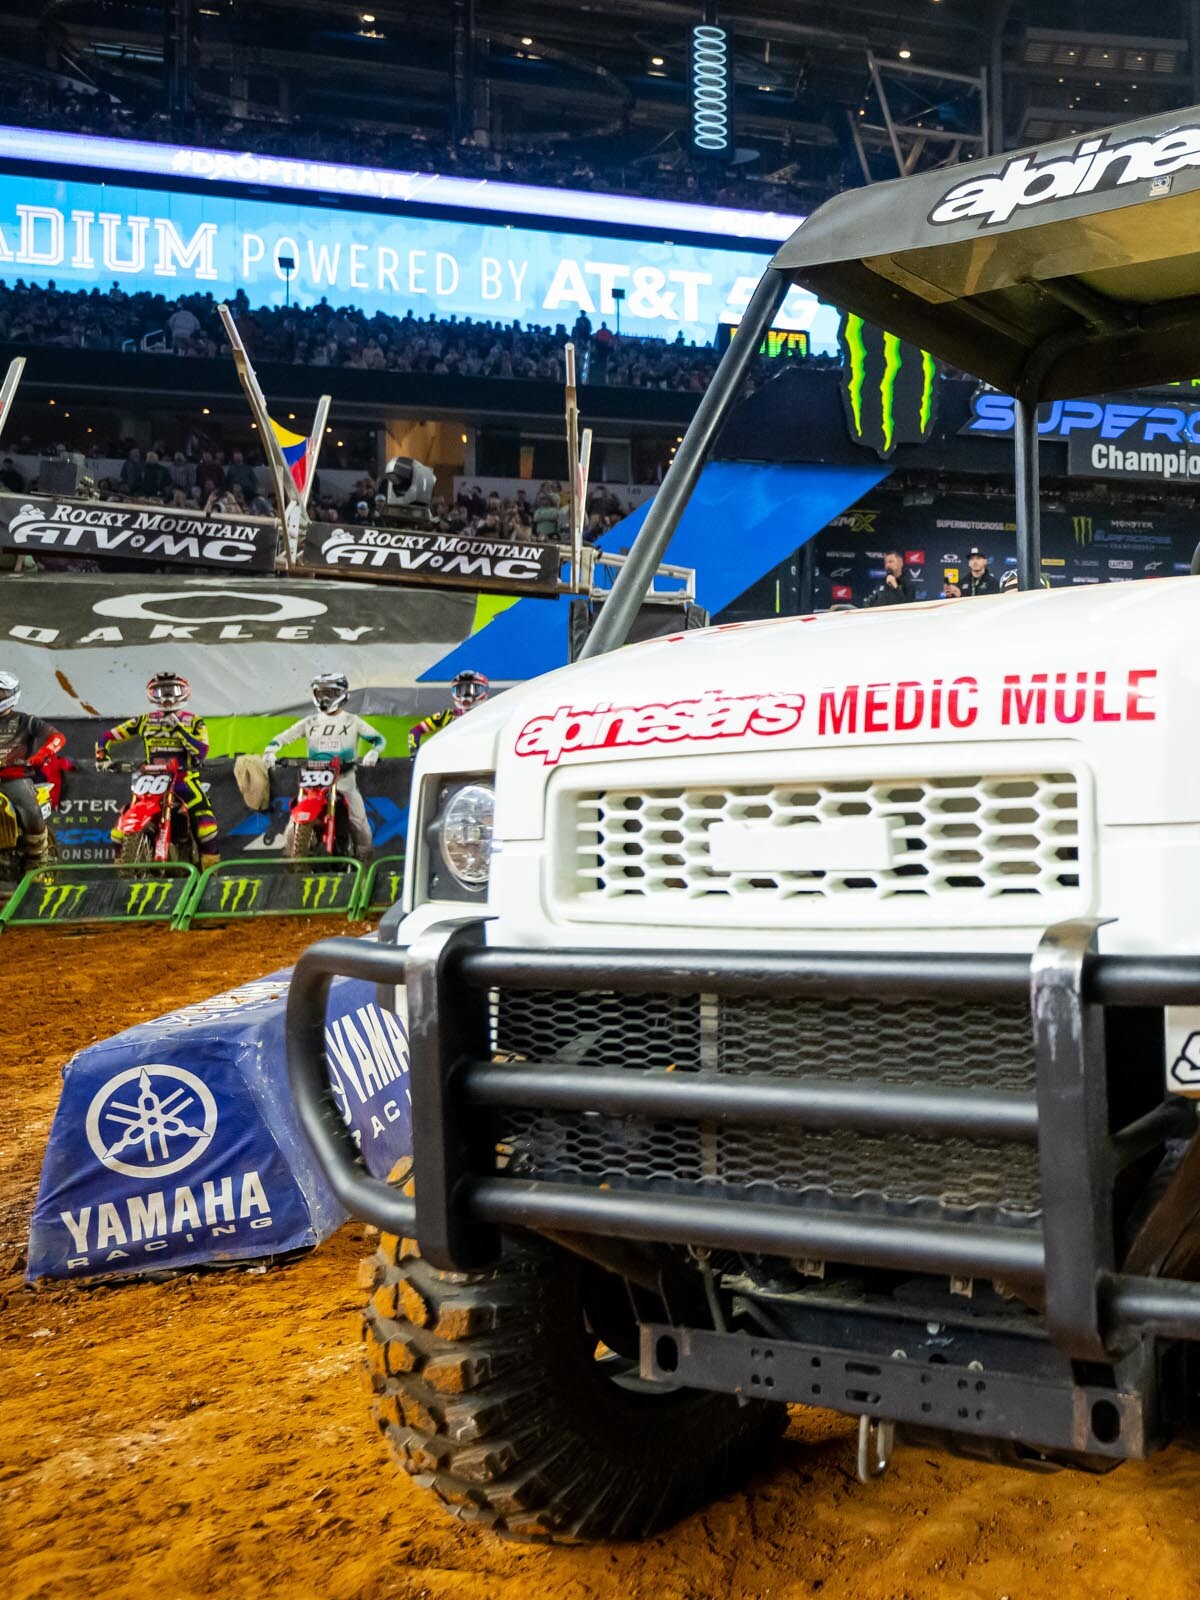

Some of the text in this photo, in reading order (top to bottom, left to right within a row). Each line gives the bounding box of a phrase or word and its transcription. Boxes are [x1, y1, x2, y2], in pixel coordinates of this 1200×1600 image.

[0, 203, 218, 281] DIUM
[241, 233, 460, 296] POWERED
[481, 257, 529, 302] BY
[541, 258, 713, 323] AT&T
[50, 503, 260, 541] ROCKY MOUNTAIN
[359, 528, 545, 561] ROCKY MOUNTAIN
[8, 623, 376, 644] OAKLEY
[309, 723, 352, 737] FOX
[514, 669, 1157, 766] alpinestars MEDIC MULE
[134, 774, 170, 796] 66
[299, 769, 334, 787] 330
[51, 815, 102, 824] ERGY
[59, 799, 120, 814] STER
[324, 1002, 410, 1104] YAMA
[60, 1170, 272, 1254] YAMAHA
[66, 1216, 274, 1271] RACING
